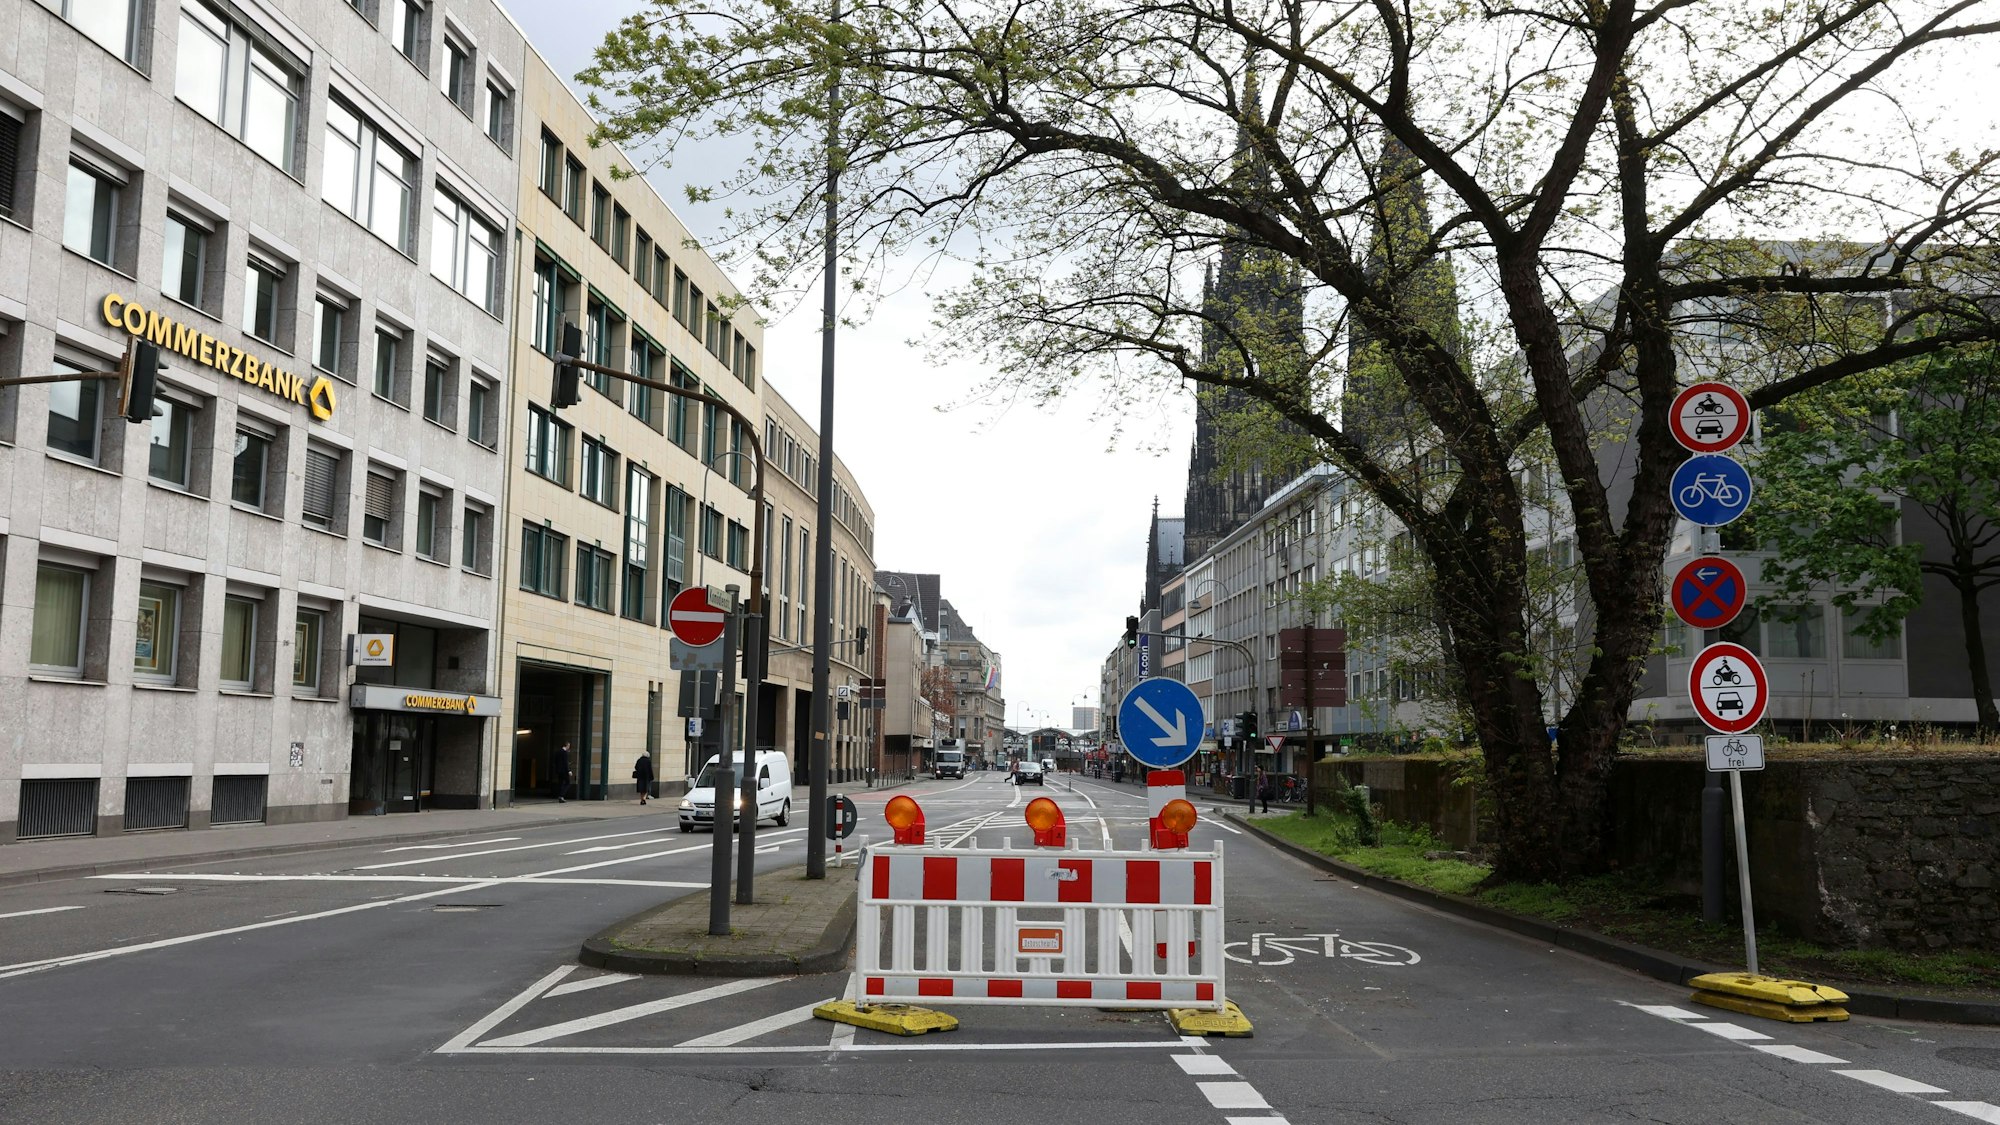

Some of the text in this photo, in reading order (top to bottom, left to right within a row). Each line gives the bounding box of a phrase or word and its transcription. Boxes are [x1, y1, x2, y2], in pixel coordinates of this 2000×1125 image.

[103, 293, 305, 405] COMMERZBANK
[406, 694, 466, 711] COMMERZBANK
[1728, 757, 1745, 767] frei
